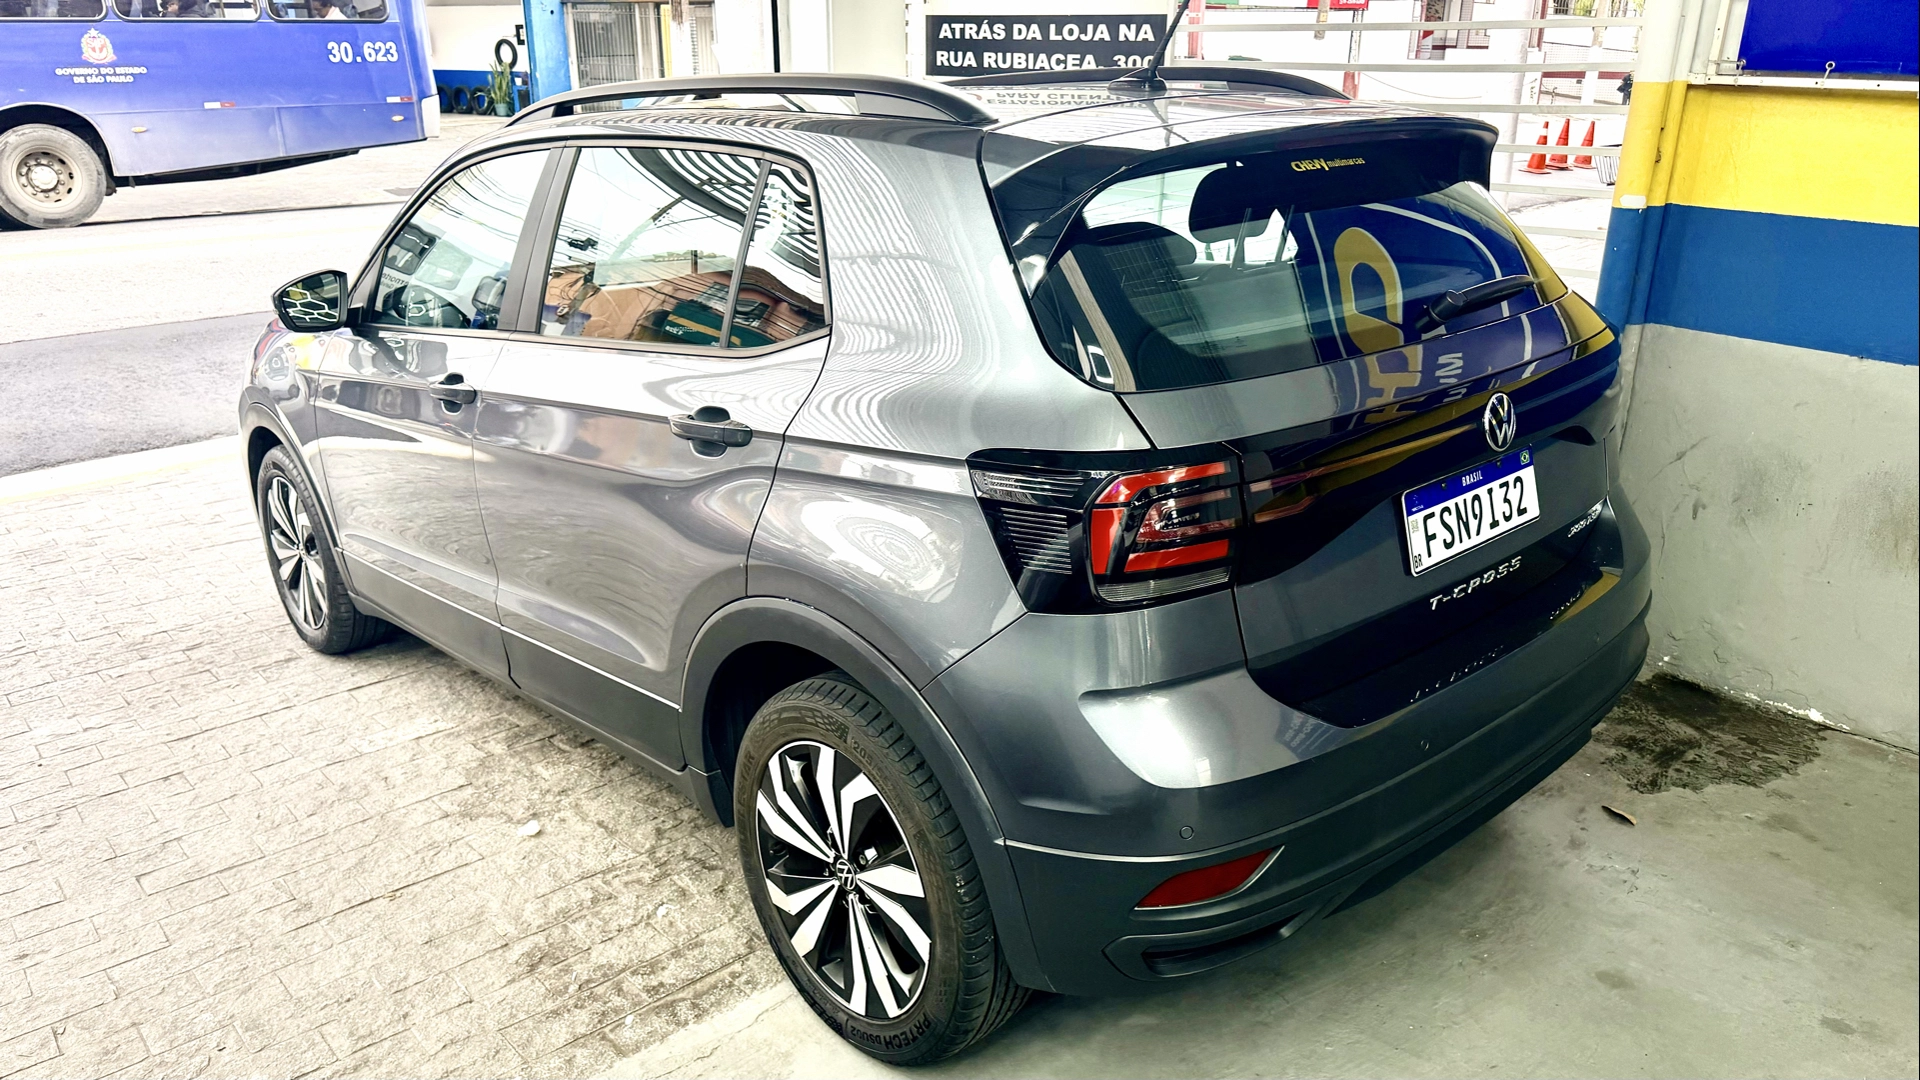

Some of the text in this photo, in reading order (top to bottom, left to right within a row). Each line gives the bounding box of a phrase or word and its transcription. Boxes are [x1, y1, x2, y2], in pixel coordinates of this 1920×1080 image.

[938, 19, 1155, 42] ATRÁS DA LOJA NA
[327, 41, 398, 64] 30.623
[936, 50, 978, 68] RUA
[55, 66, 148, 75] GOVERNO DO ESTADO
[86, 75, 105, 83] SÃO
[1461, 470, 1484, 487] BRASIL
[1422, 475, 1528, 558] FSN9I32
[1413, 553, 1423, 569] BR
